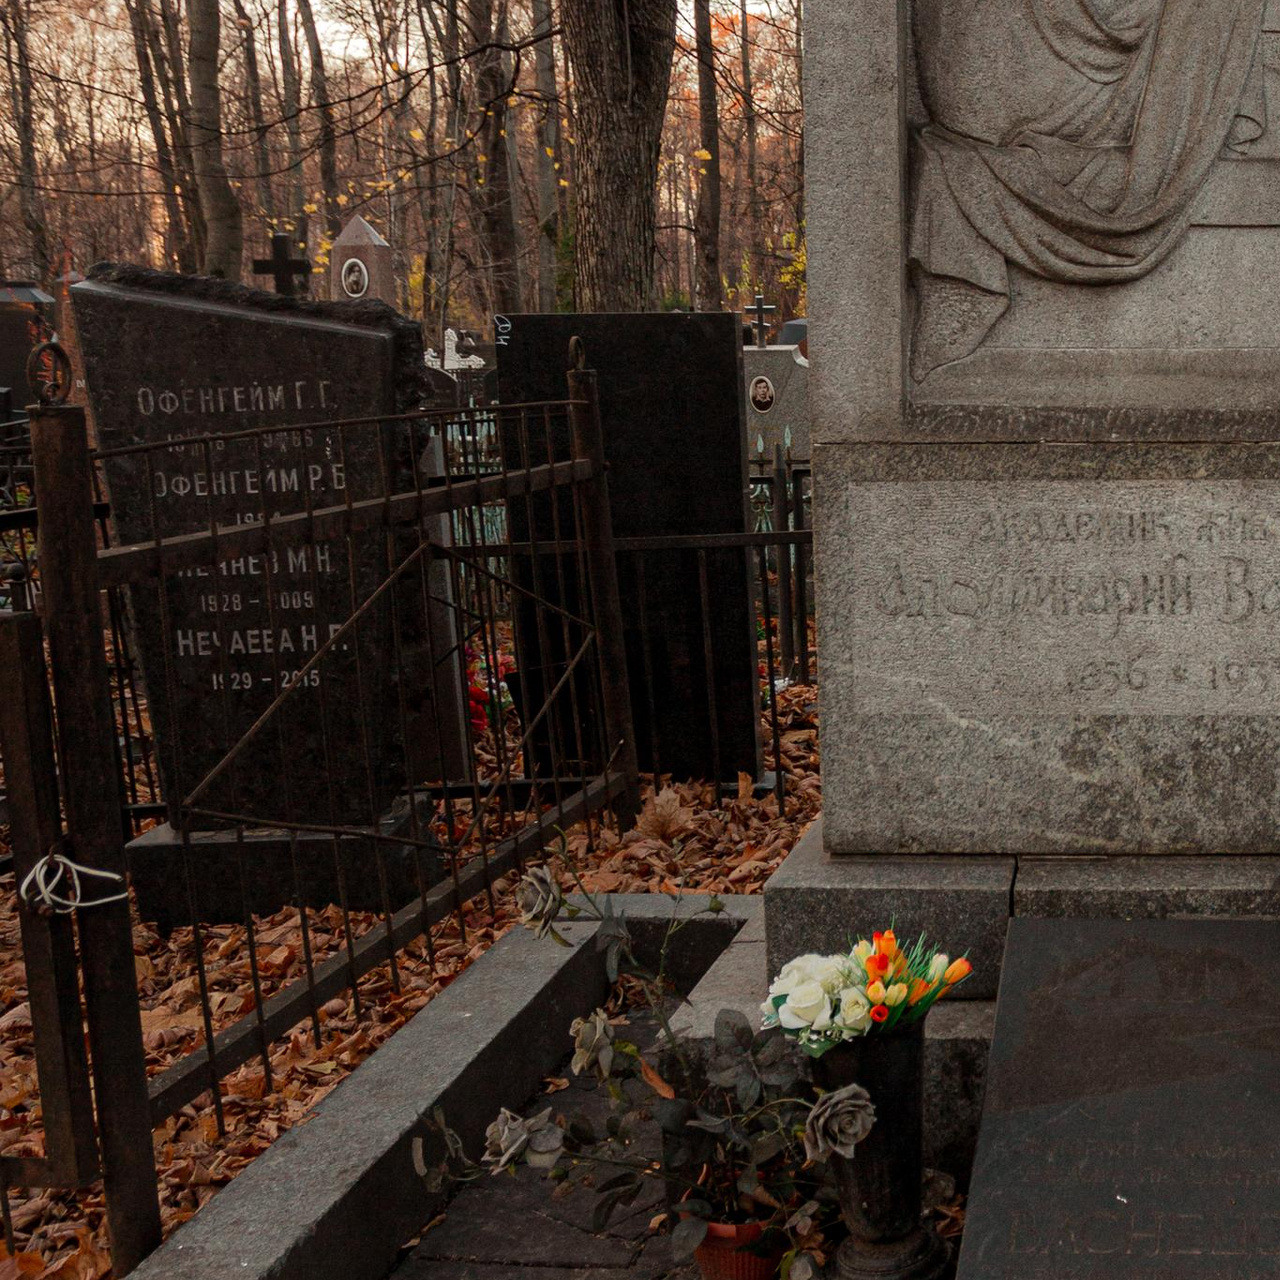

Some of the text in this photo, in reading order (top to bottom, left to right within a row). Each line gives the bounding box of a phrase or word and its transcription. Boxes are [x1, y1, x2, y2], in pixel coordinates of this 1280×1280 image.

[136, 380, 286, 416] ОФЕНГЕЙМ
[978, 510, 1171, 543] АКАДЕМИК
[201, 594, 242, 613] 1928
[274, 591, 315, 610] 009
